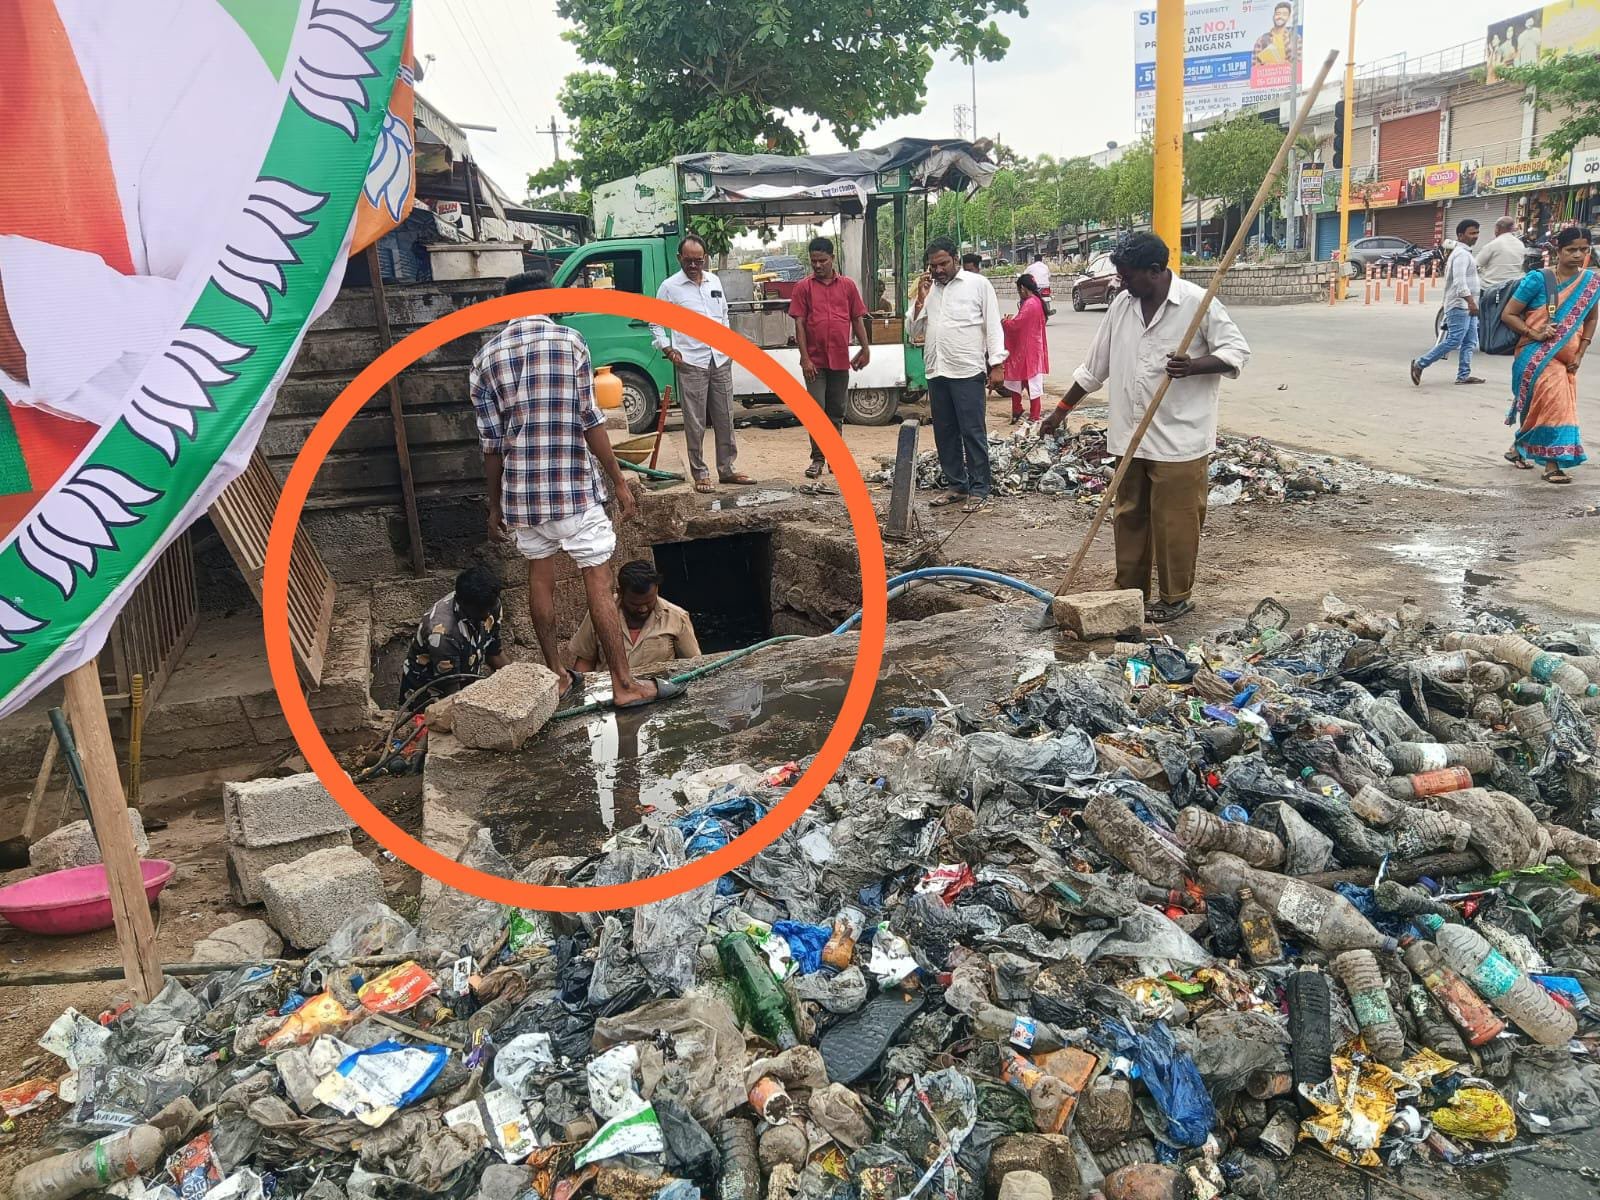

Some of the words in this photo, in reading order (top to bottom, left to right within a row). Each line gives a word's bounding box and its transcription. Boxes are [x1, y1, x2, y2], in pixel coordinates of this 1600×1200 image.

[1190, 6, 1229, 16] UNIVERSITY
[1189, 27, 1201, 35] AT
[1204, 19, 1236, 33] NO.1
[1188, 31, 1246, 43] UNIVERSITY
[1496, 160, 1546, 176] RAGHAVENDRA
[1496, 176, 1517, 186] SUPER
